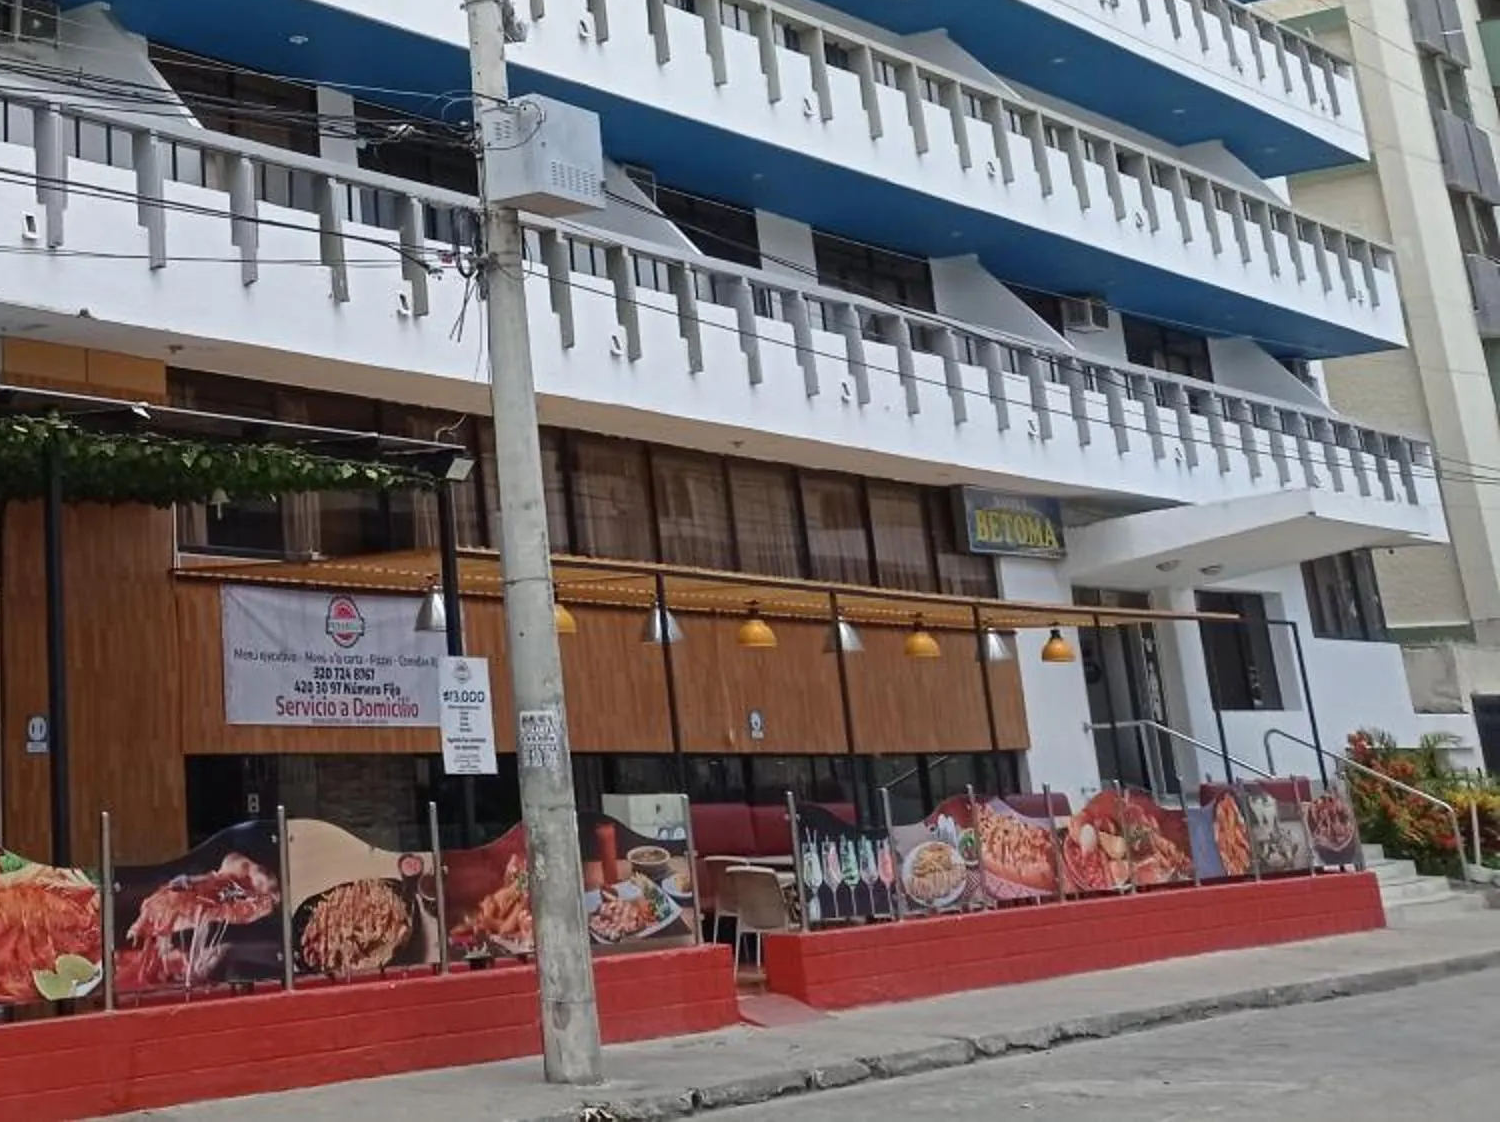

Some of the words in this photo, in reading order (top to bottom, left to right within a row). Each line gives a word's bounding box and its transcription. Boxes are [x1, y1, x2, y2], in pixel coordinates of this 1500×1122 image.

[974, 508, 1060, 549] BETOMA
[293, 679, 314, 694] 420
[315, 681, 328, 695] 30
[275, 694, 337, 717] Servicio
[341, 703, 349, 717] a
[353, 697, 419, 719] Domicilio
